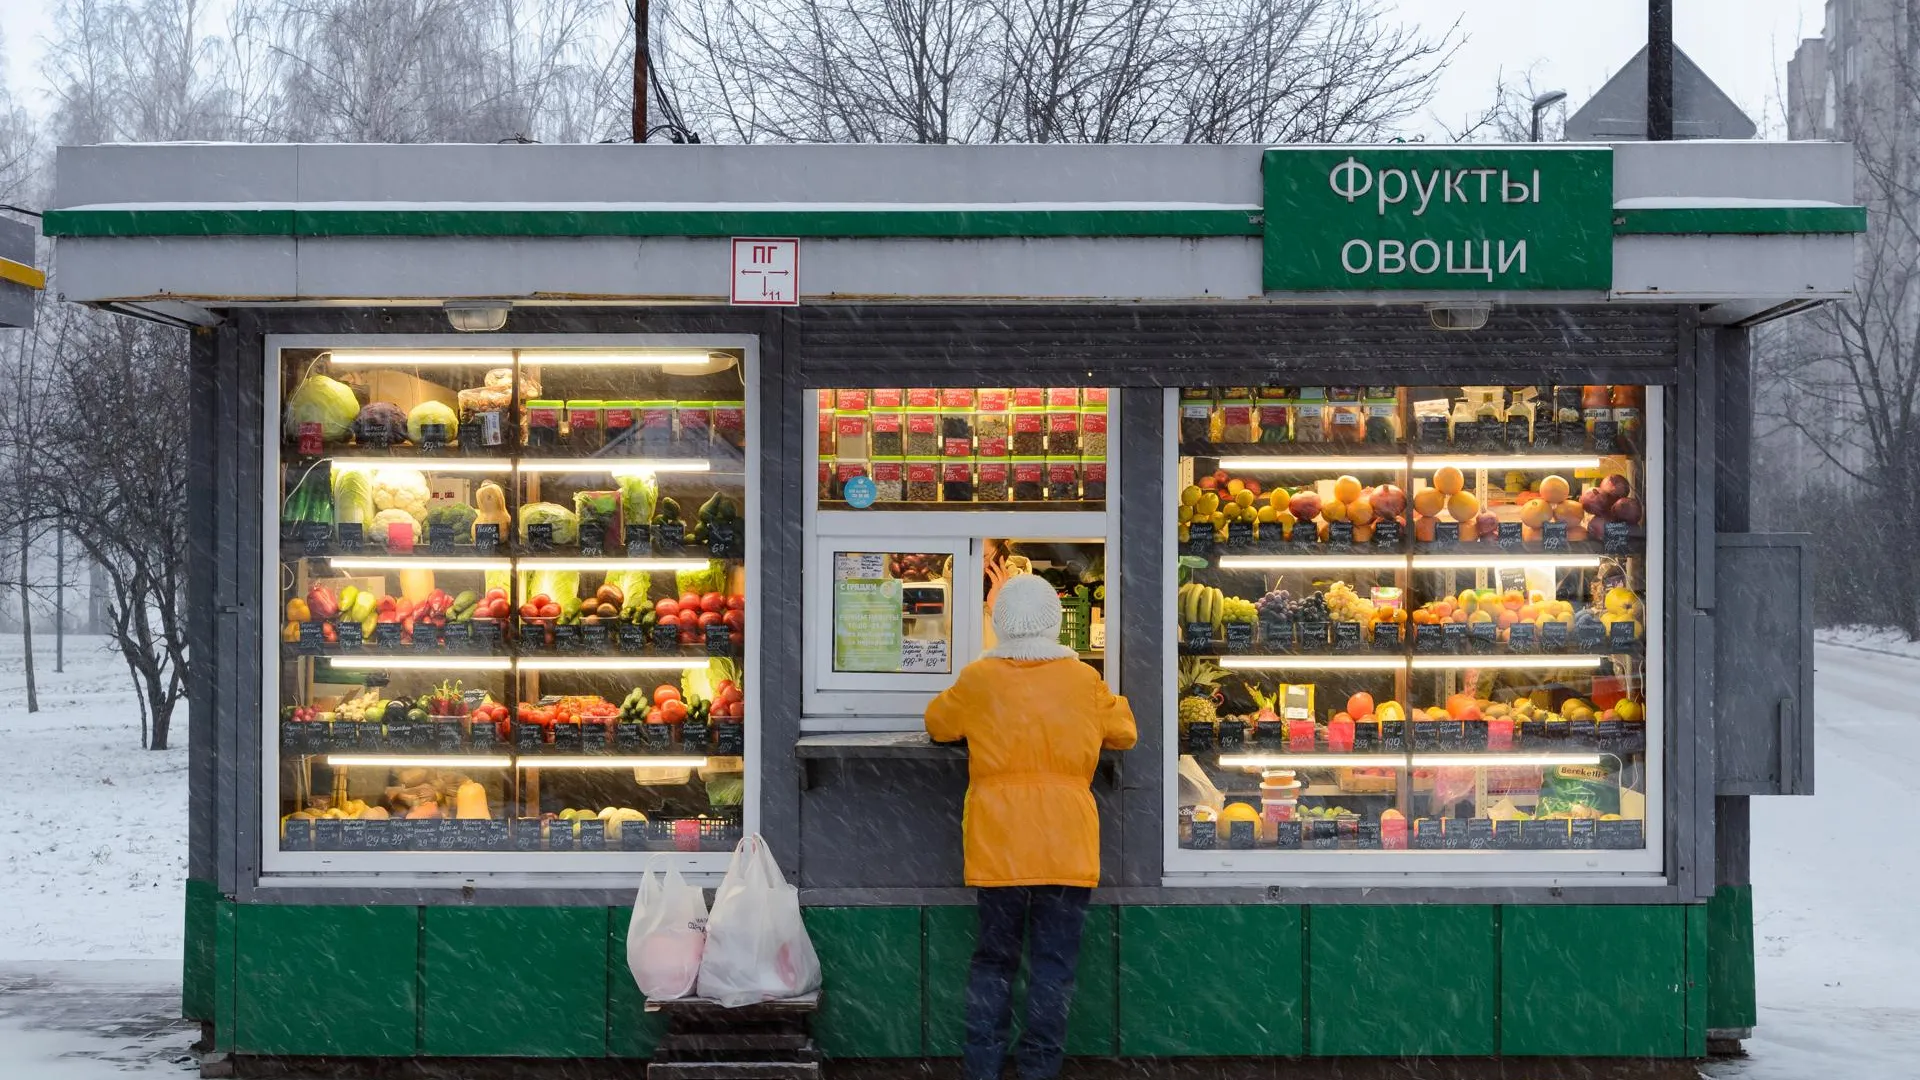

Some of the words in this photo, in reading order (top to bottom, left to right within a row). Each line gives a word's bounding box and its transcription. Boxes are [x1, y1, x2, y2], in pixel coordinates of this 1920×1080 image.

[1329, 156, 1540, 216] Фрукты
[753, 245, 778, 264] ПГ
[1341, 238, 1527, 283] овощи
[769, 291, 780, 301] 11
